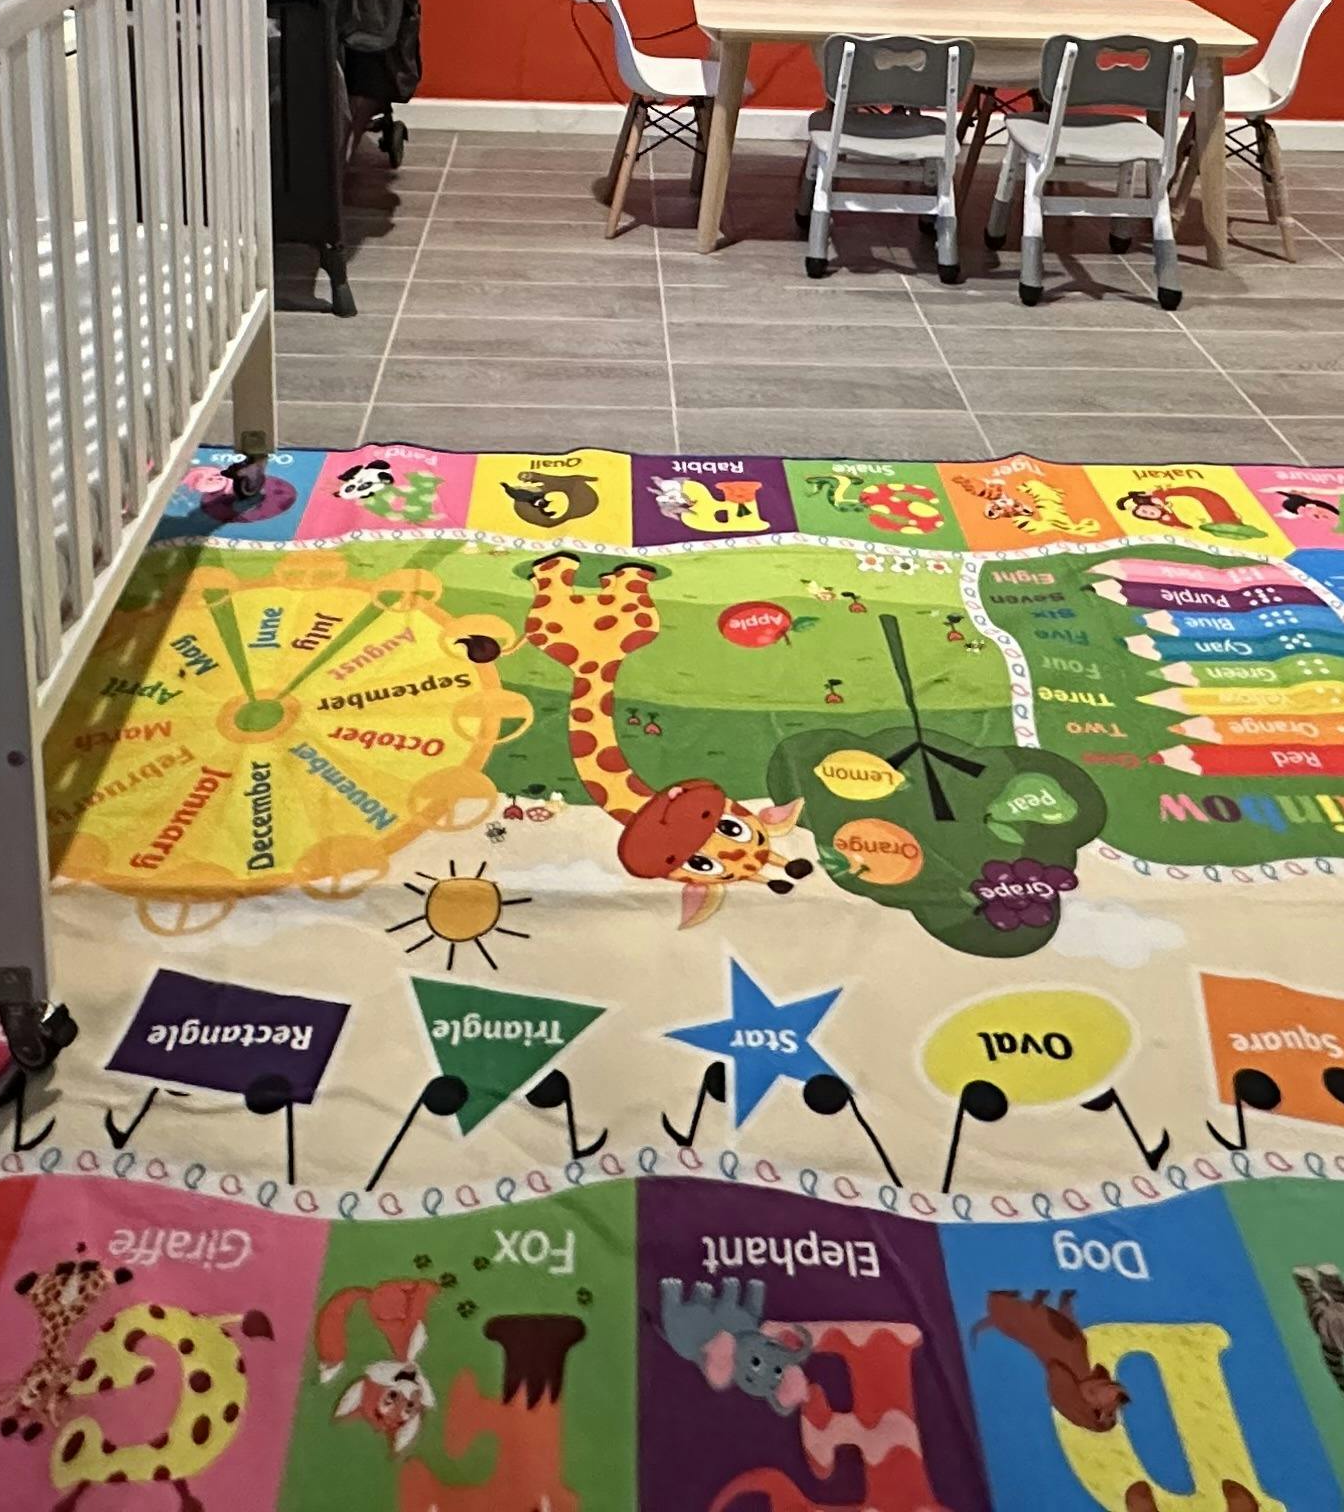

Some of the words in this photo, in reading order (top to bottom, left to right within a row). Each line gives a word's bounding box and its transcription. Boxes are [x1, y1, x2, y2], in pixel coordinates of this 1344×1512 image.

[210, 452, 295, 466] Ocus
[528, 455, 583, 472] Quail
[670, 460, 745, 475] Rabbit
[831, 462, 895, 477] Snake
[992, 457, 1047, 480] Tiger
[1129, 467, 1205, 483] Uakari
[858, 482, 947, 536] S
[992, 570, 1056, 586] Eight
[1158, 566, 1204, 579] Pink
[1160, 587, 1230, 609] Purple
[246, 604, 283, 652] June
[290, 610, 345, 654] July
[727, 614, 785, 633] Apple
[1184, 615, 1237, 631] Blue
[1032, 628, 1091, 645] Five
[1194, 636, 1254, 656] Cyan
[169, 633, 221, 678] May
[324, 624, 418, 681] August
[1038, 656, 1102, 680] Four
[1206, 663, 1279, 681] Green
[99, 675, 185, 708] April
[314, 671, 475, 715] September
[1037, 686, 1116, 709] Three
[1216, 689, 1295, 706] Yellow
[70, 719, 175, 752] March
[1064, 719, 1129, 738] Two
[1227, 717, 1321, 738] Orange
[326, 724, 446, 760] October
[1270, 749, 1323, 768] Red
[287, 739, 400, 833] November
[821, 762, 896, 785] Lemon
[246, 759, 275, 872] December
[1006, 789, 1059, 817] Pear
[127, 765, 234, 873] January
[833, 834, 920, 861] Orange
[978, 880, 1057, 901] Grape
[145, 1018, 316, 1054] Rectangle
[430, 1011, 566, 1047] Triangle
[729, 1025, 800, 1056] Star
[975, 1028, 1076, 1064] Oval
[106, 1226, 254, 1273] Giraffe
[491, 1227, 578, 1275] Fox
[700, 1234, 882, 1281] Elephant
[1052, 1230, 1149, 1281] Dog
